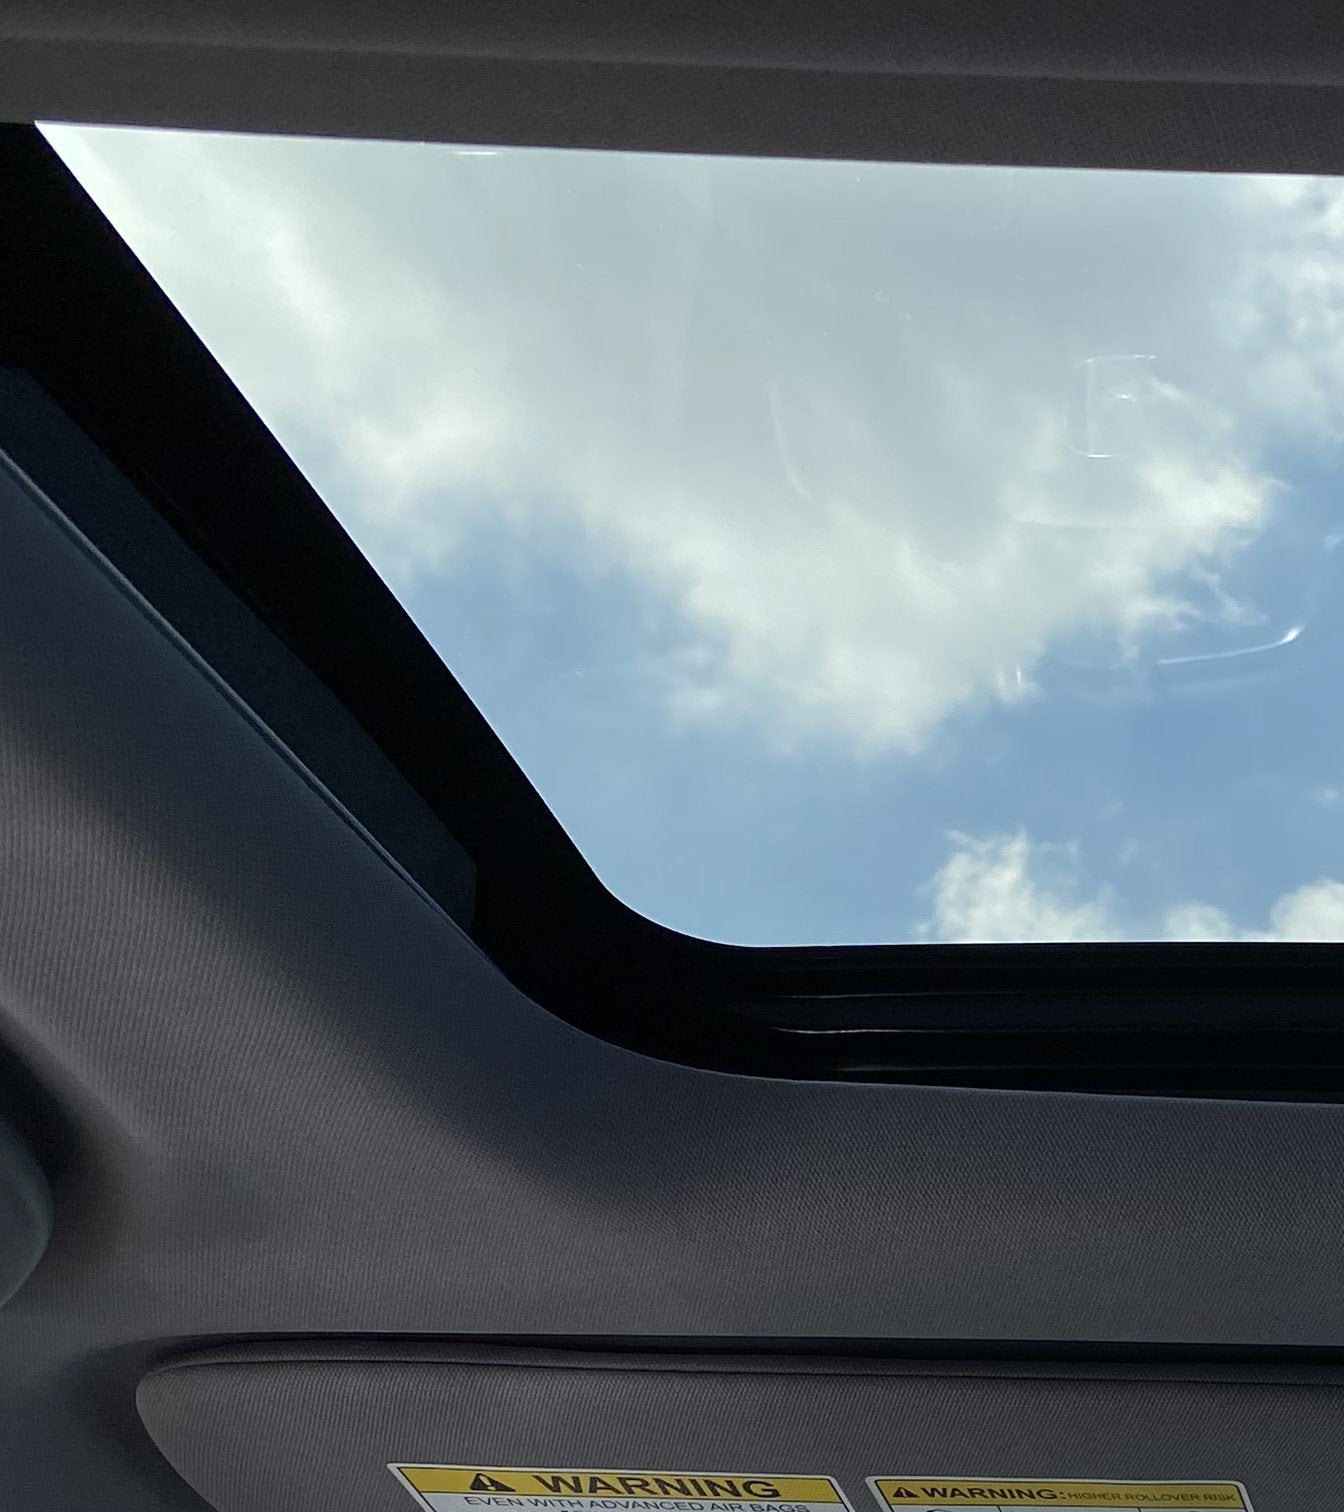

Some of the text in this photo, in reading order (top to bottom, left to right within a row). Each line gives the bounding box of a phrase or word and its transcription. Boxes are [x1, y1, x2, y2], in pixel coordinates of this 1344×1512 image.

[532, 1475, 782, 1498] WARNING
[921, 1488, 1237, 1502] WARNING: HIGHER ROLLOVER RISK
[463, 1497, 525, 1508] EVEN
[526, 1498, 585, 1509] WITH
[590, 1500, 705, 1511] ADVANCED
[710, 1503, 746, 1512] AIR
